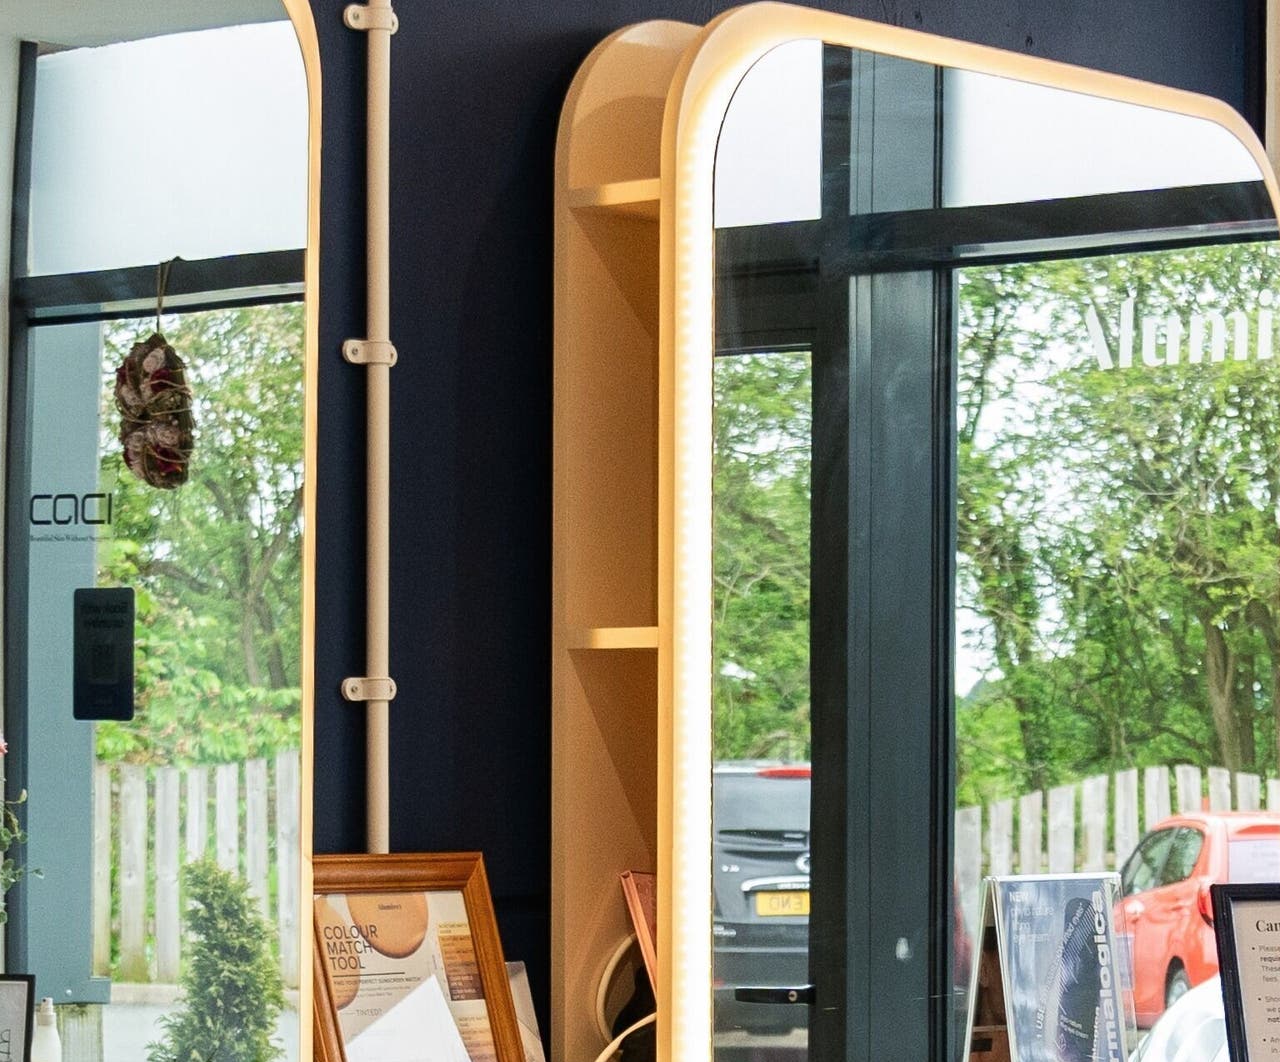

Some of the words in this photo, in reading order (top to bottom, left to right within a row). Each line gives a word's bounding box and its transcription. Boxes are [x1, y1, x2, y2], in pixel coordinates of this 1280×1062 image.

[324, 924, 378, 940] COLOUR
[326, 940, 373, 955] MATCH
[329, 956, 366, 970] TOOL
